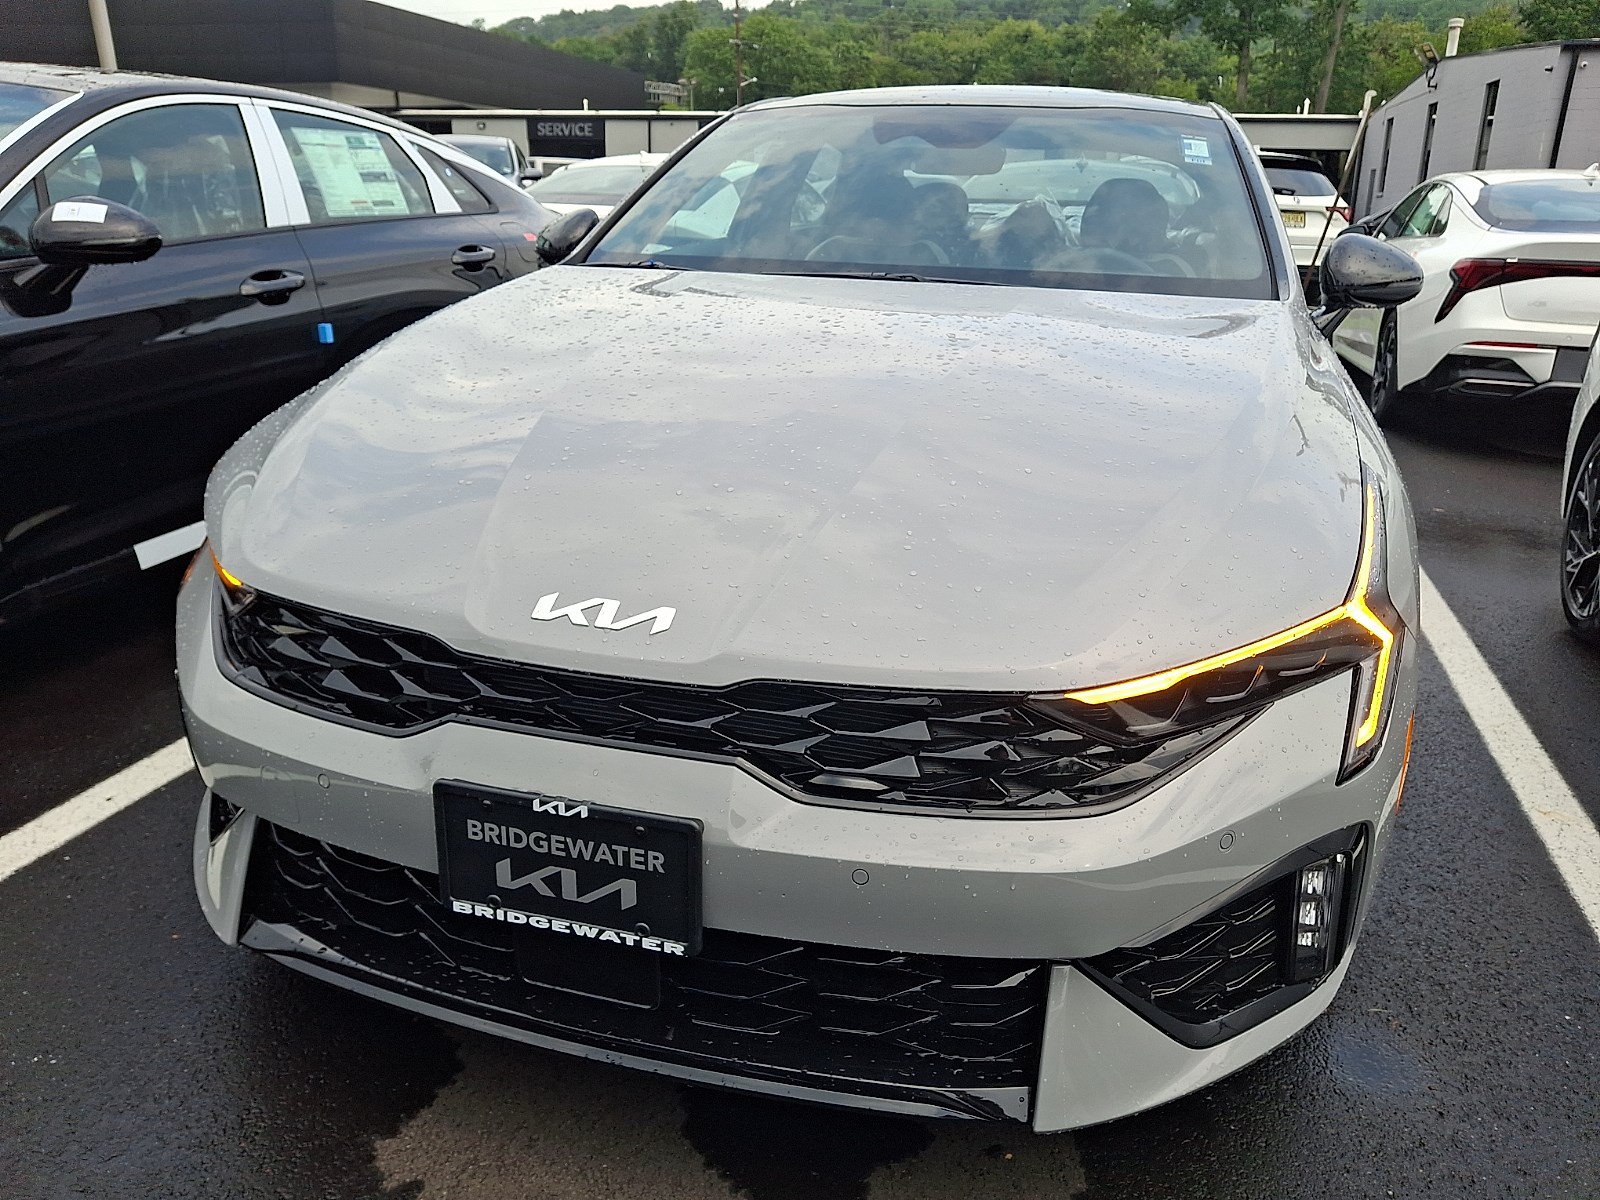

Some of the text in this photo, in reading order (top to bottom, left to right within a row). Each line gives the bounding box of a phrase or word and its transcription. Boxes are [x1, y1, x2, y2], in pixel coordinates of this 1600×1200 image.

[536, 122, 594, 137] SERVICE
[531, 592, 677, 635] KIA
[532, 798, 589, 818] KIA
[466, 819, 665, 873] BRIDGEWATER
[495, 858, 637, 910] KIA
[452, 900, 685, 955] BRIDGEWATER
